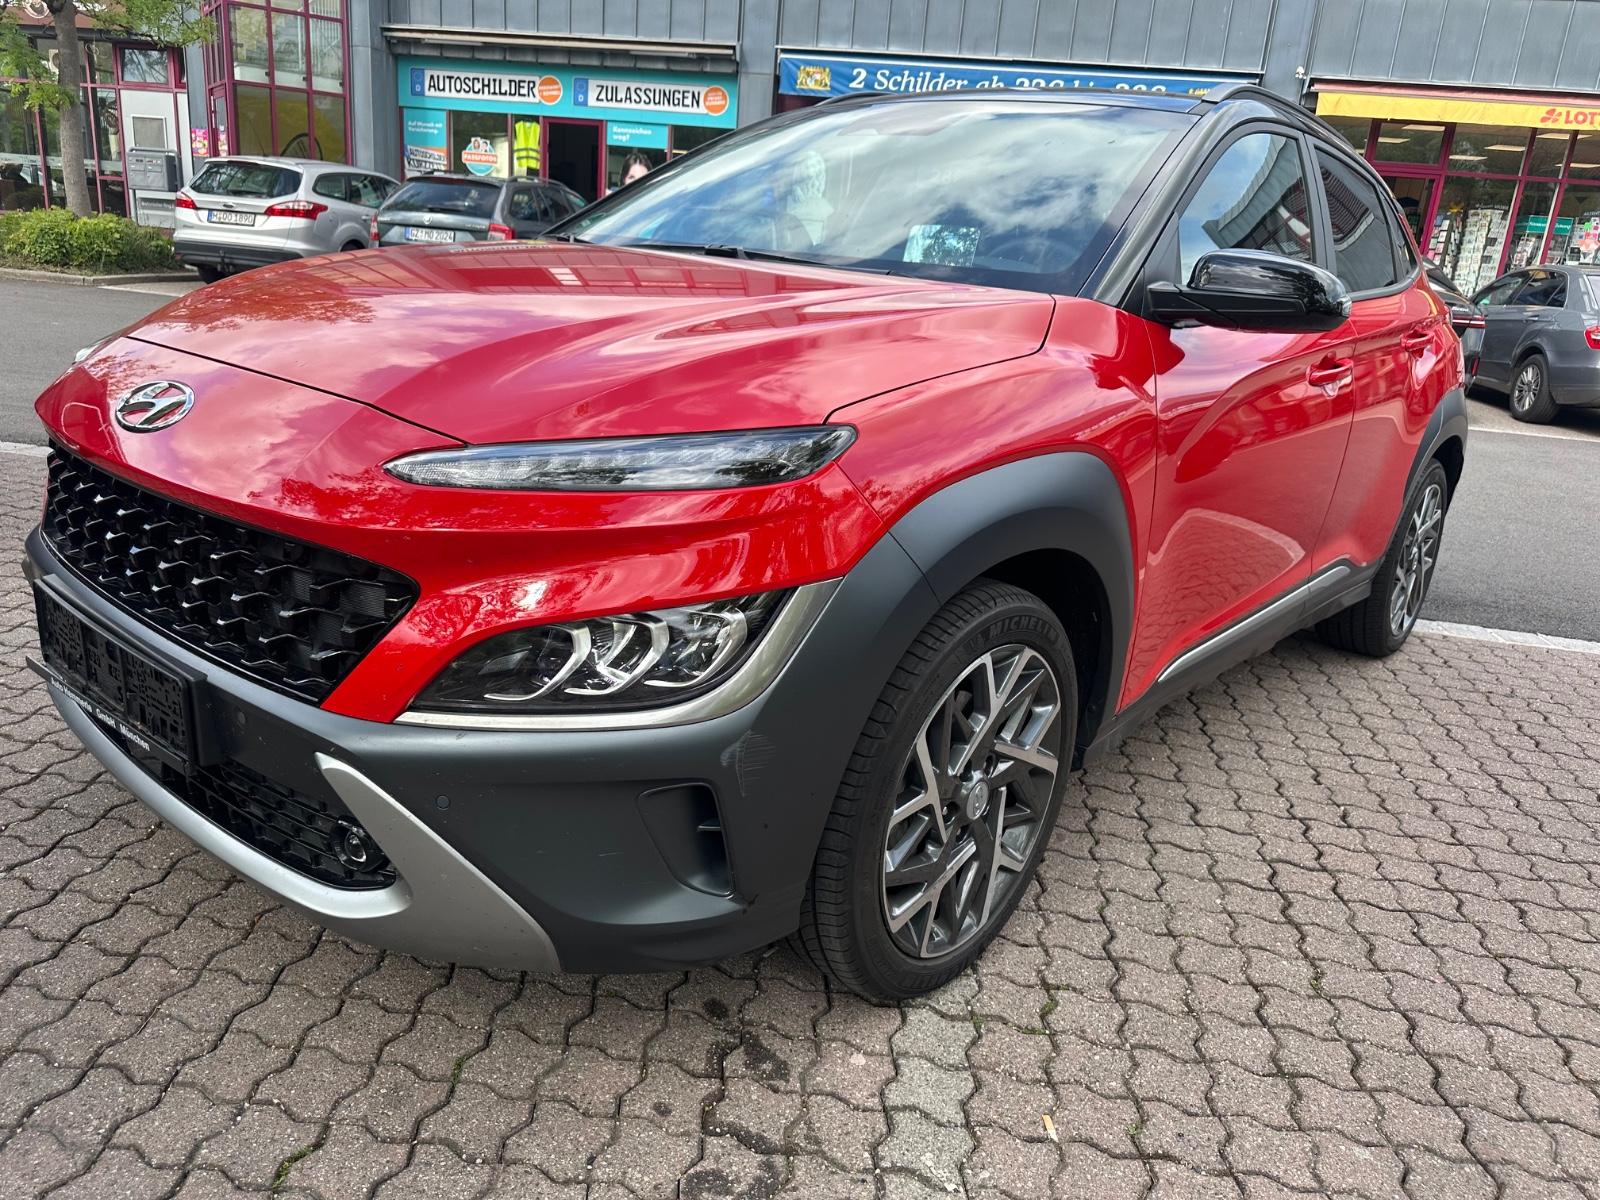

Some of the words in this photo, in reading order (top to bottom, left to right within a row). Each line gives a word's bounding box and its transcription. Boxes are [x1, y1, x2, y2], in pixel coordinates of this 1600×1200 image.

[428, 74, 536, 98] AUTOSCHILDER
[849, 68, 867, 89] 2
[874, 69, 968, 93] Schilder
[595, 84, 701, 109] ZULASSUNGEN
[1564, 110, 1600, 126] LOT
[613, 126, 652, 135] Kennzeichen
[613, 134, 630, 142] weg?
[463, 153, 497, 162] PASSFOTOS
[988, 615, 1060, 641] MICHELIN
[96, 708, 116, 728] GmbH
[120, 723, 150, 752] München
